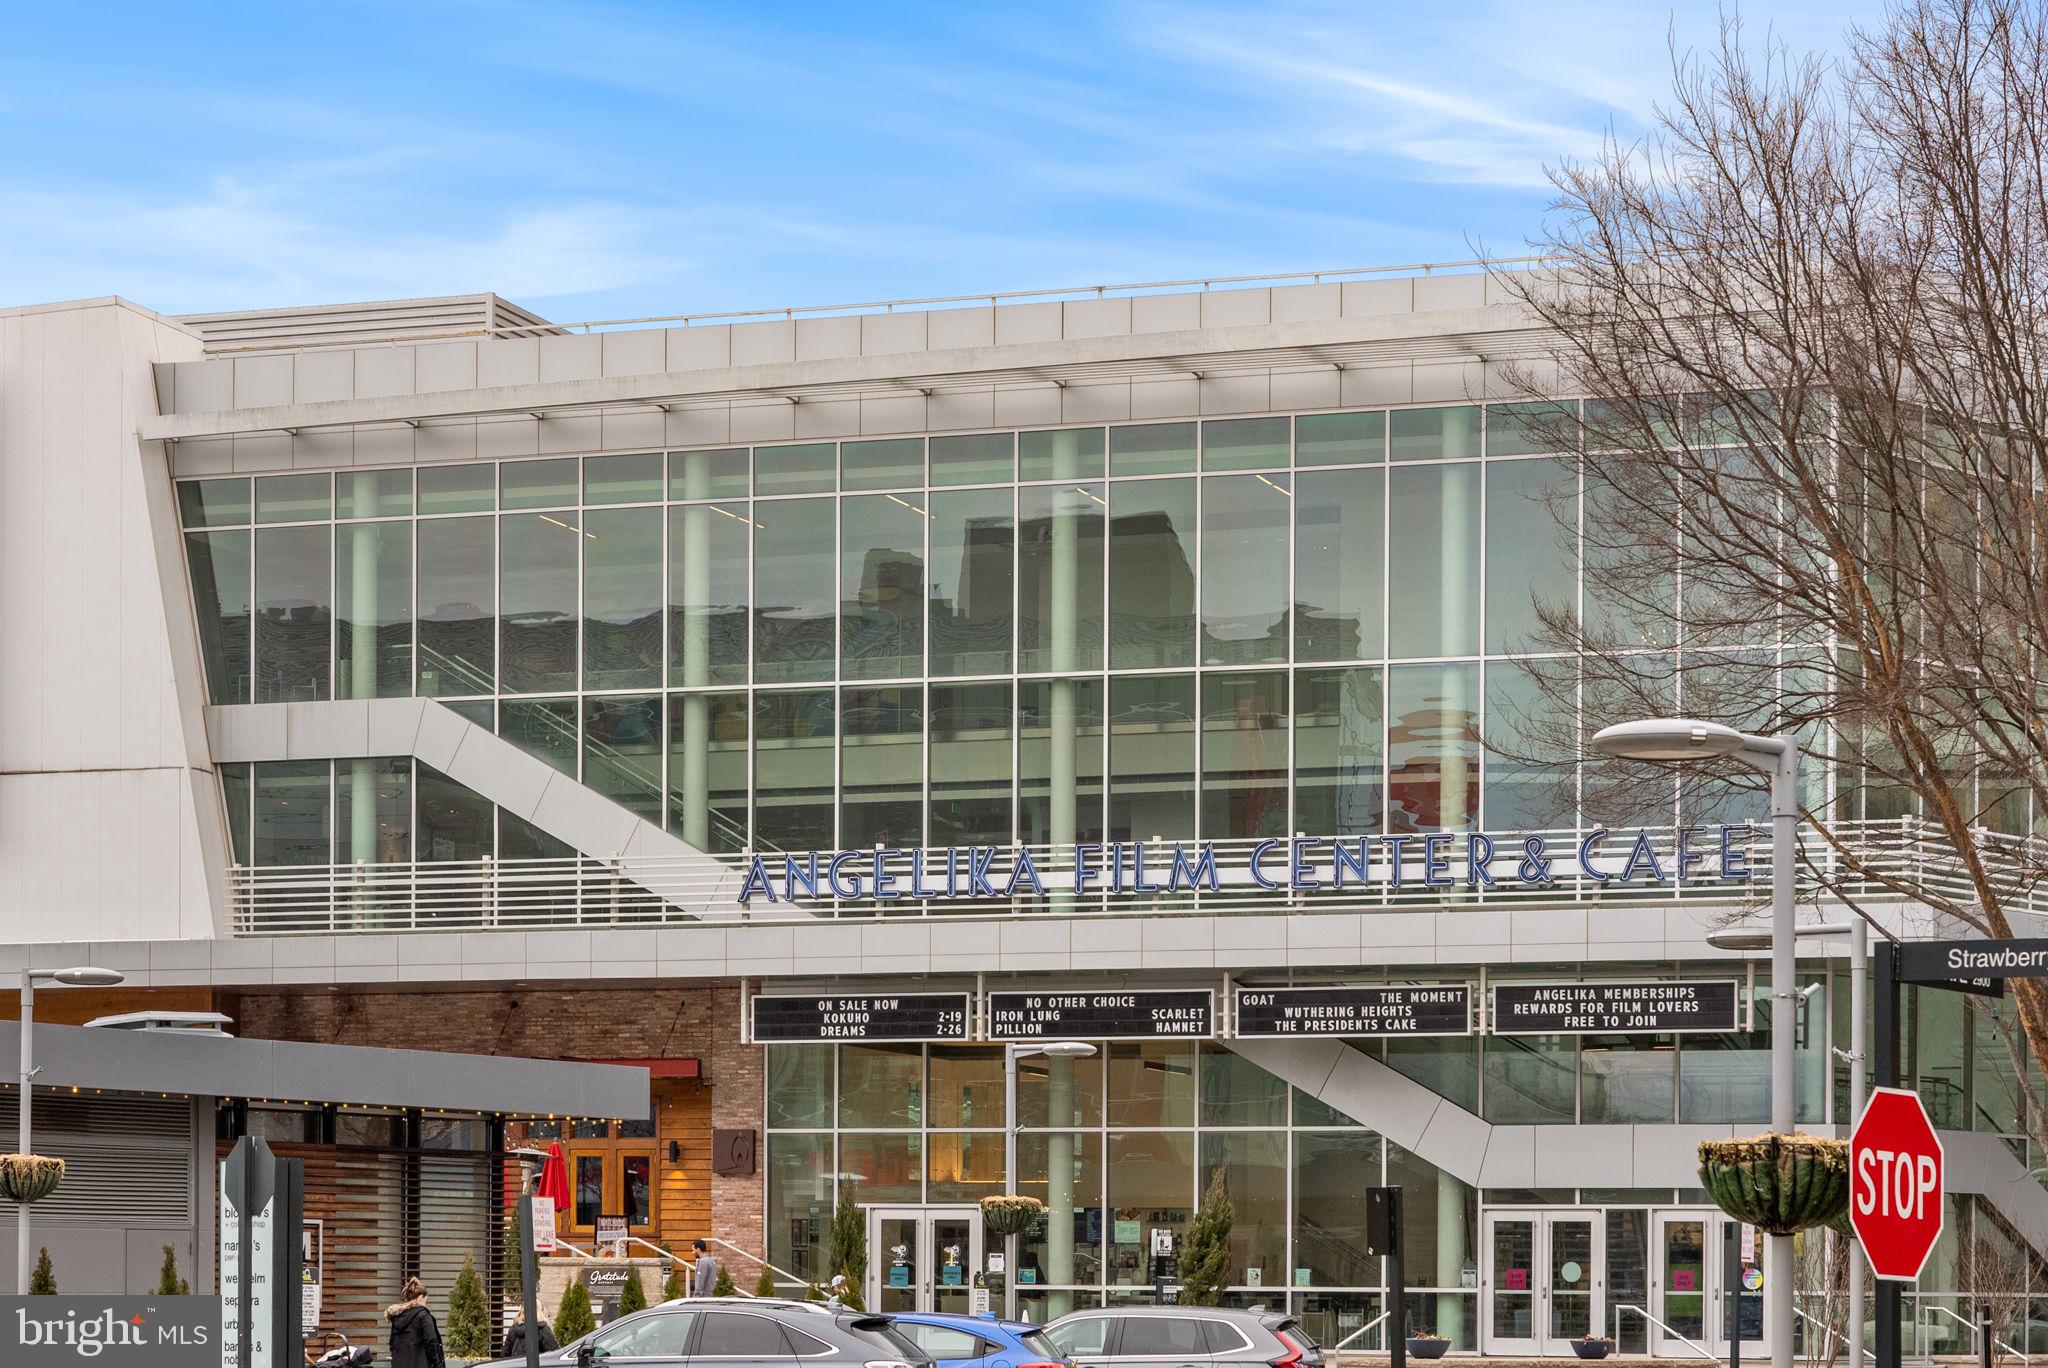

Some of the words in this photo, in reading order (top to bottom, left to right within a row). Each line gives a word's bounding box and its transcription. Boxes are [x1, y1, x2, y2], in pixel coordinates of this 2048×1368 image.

[739, 847, 1044, 902] ANGELIKA
[1074, 840, 1220, 895] FILM
[1249, 833, 1496, 888] CENTER
[1517, 834, 1553, 883] &
[1578, 826, 1752, 881] CAFE
[1242, 994, 1275, 1005] GOAT
[1380, 992, 1402, 1003] THE
[1410, 991, 1463, 1003] MOMENT
[1534, 989, 1596, 1000] ANGELIKA
[1604, 987, 1695, 999] MEMBERSHIPS
[818, 1000, 833, 1011] ON
[839, 1000, 868, 1010] SALE
[874, 999, 899, 1010] NOW
[1026, 997, 1041, 1008] NO
[1048, 997, 1086, 1008] OTHER
[1093, 996, 1135, 1007] CHOICE
[1514, 1003, 1572, 1014] REWARDS
[1580, 1002, 1604, 1013] FOR
[1612, 1002, 1642, 1013] FILM
[1649, 1001, 1699, 1012] LOVERS
[823, 1012, 870, 1023] KOKUHO
[938, 1011, 962, 1022] 2-19
[996, 1010, 1023, 1021] IRON
[1030, 1010, 1060, 1021] LUNG
[1151, 1008, 1204, 1019] SCARLET
[1284, 1007, 1354, 1018] WUTHERING
[1361, 1005, 1412, 1017] HEIGHTS
[1275, 1020, 1297, 1031] THE
[1304, 1019, 1378, 1031] PRESIDENTS
[1385, 1018, 1416, 1030] CAKE
[1564, 1016, 1595, 1027] FREE
[1602, 1015, 1619, 1027] TO
[1626, 1015, 1657, 1027] JOIN
[820, 1026, 866, 1036] DREAMS
[996, 1023, 1042, 1034] PILLION
[1156, 1021, 1204, 1033] HAMNET
[1856, 1147, 1937, 1219] STOP
